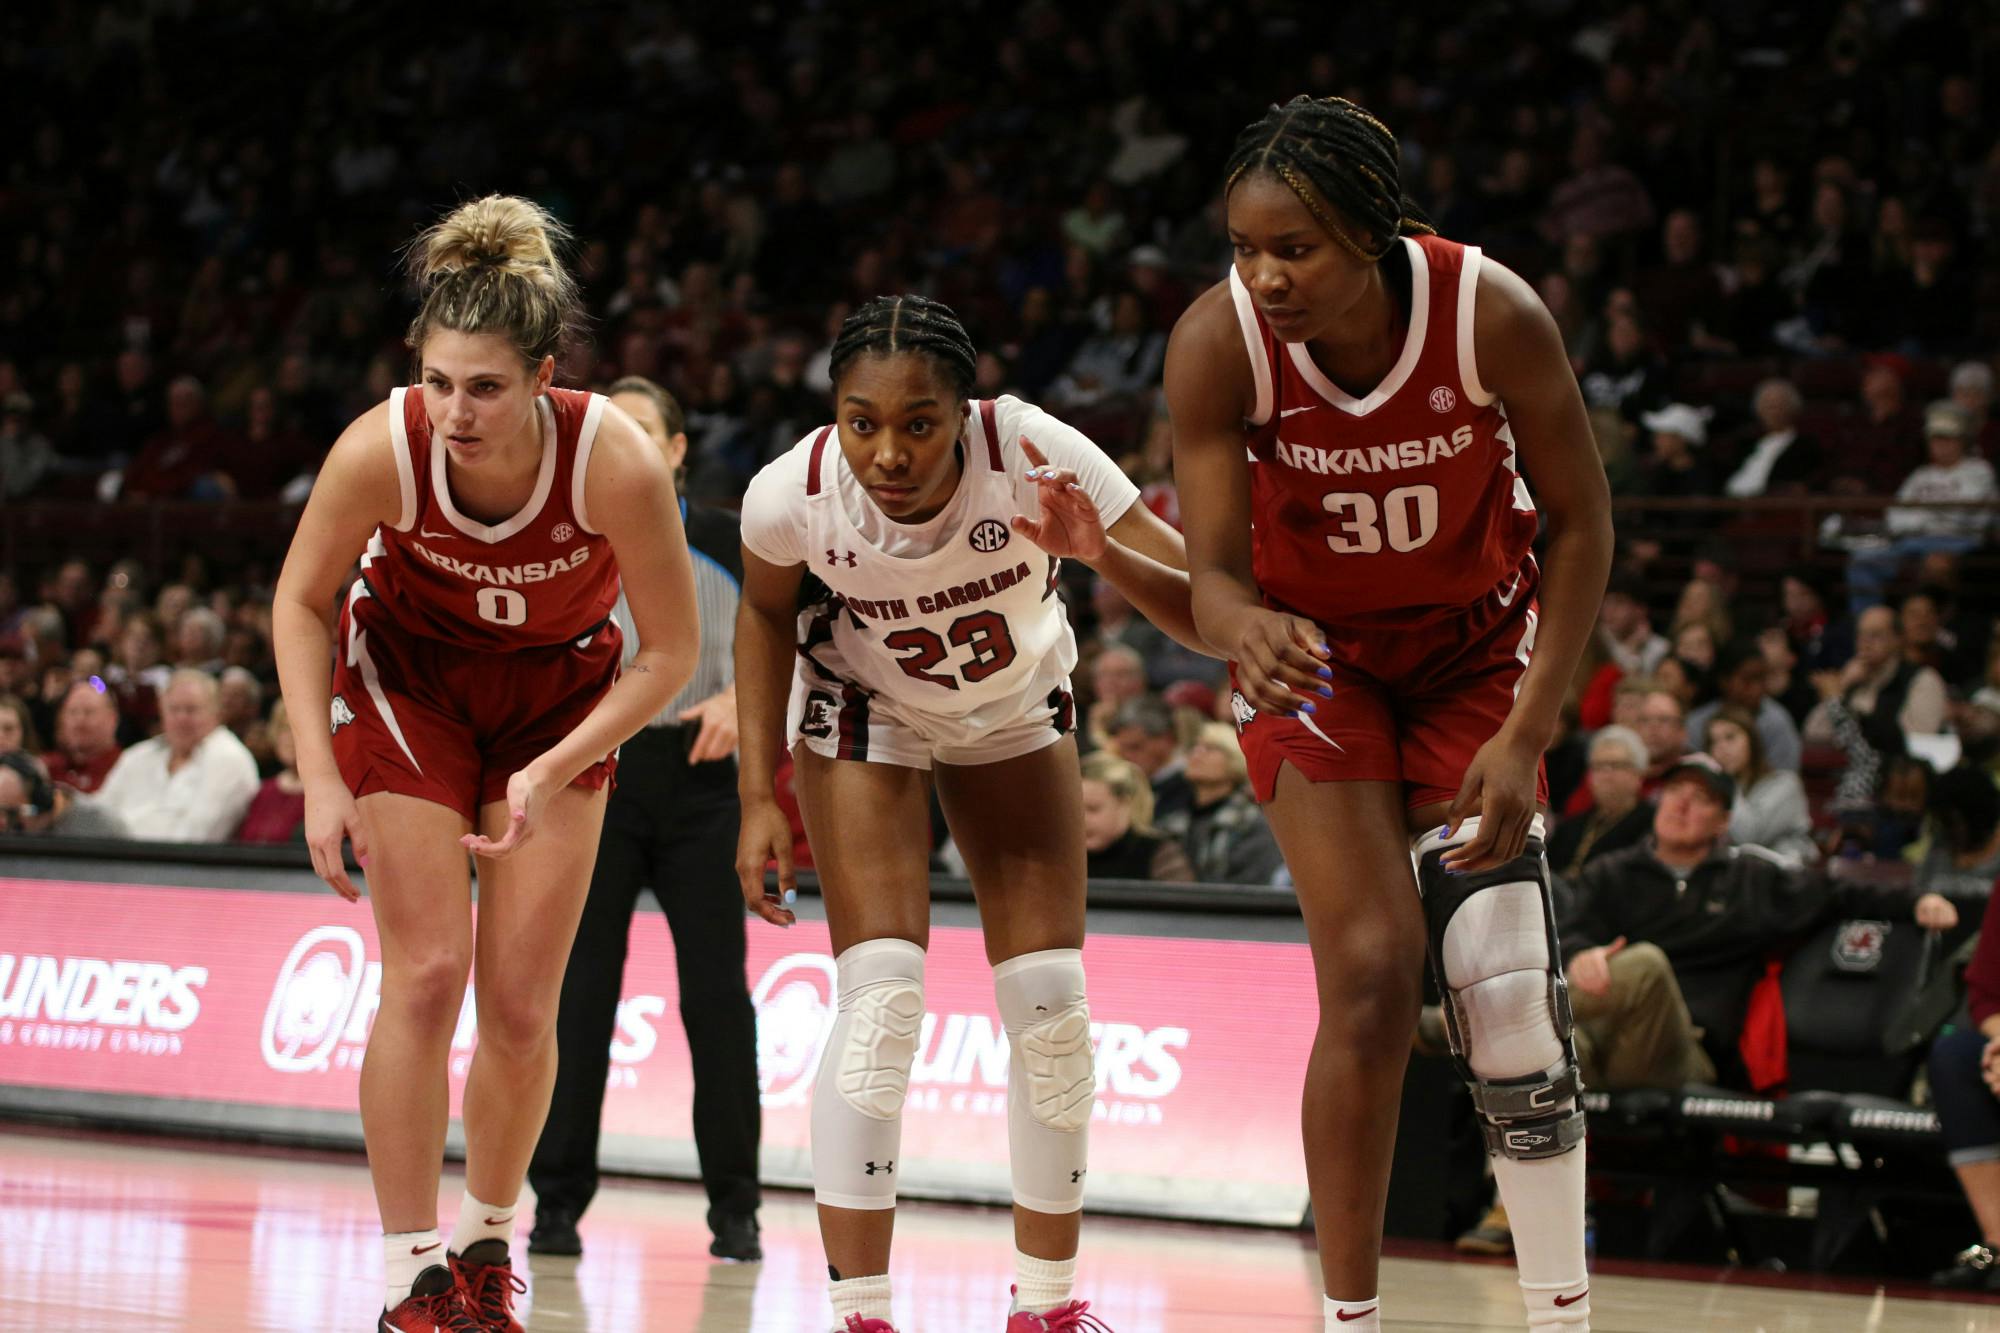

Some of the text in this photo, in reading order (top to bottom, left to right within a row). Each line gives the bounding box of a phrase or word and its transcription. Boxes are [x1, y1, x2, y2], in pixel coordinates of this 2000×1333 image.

[1431, 387, 1455, 412] SEC
[1276, 425, 1473, 475] ARKANSAS
[552, 523, 574, 542] SEC
[971, 521, 1007, 551] SEC
[1322, 485, 1438, 553] 30
[412, 541, 589, 585] ARKANSAS
[476, 587, 527, 626] 0
[917, 561, 1031, 614] CAROLINA
[883, 609, 1017, 690] 23
